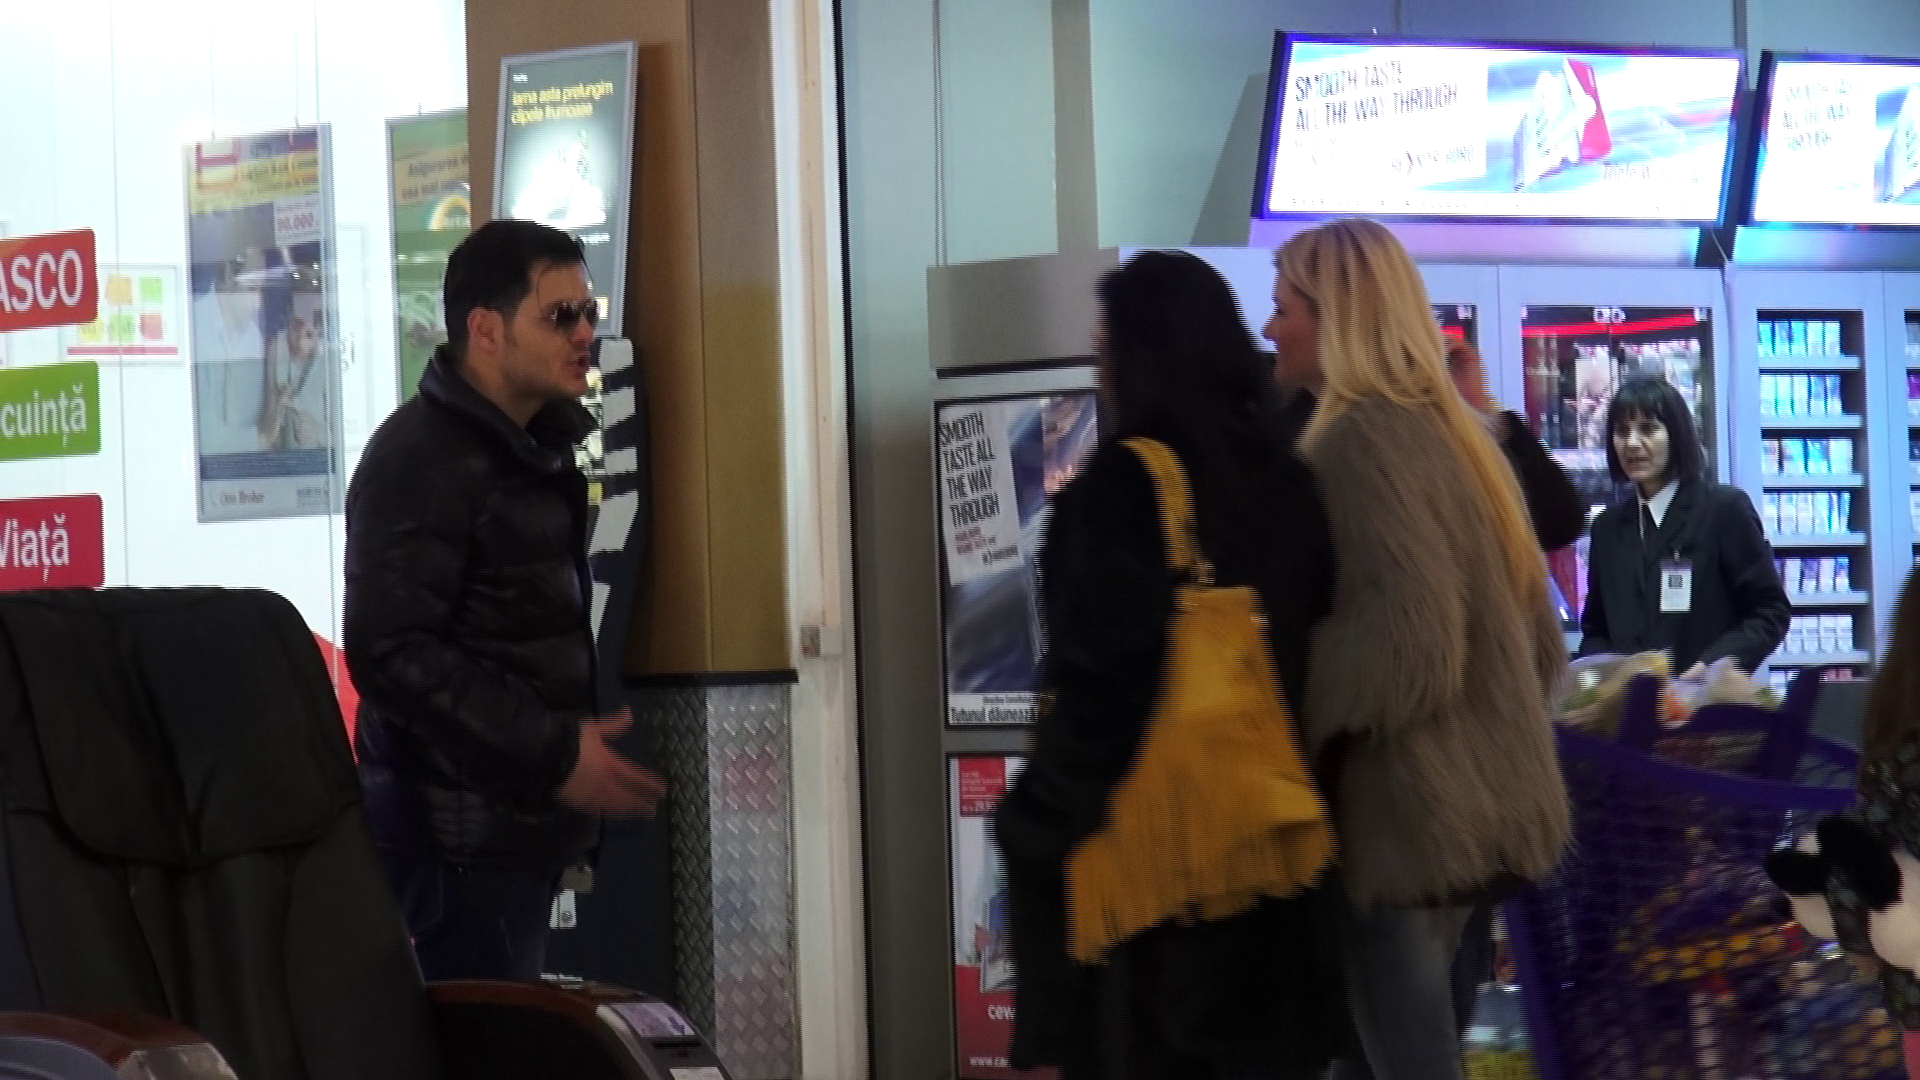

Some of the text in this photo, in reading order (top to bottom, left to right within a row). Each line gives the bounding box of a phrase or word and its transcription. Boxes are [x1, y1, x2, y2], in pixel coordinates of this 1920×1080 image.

[1295, 61, 1403, 102] SMOOTH TASTE
[1325, 101, 1347, 127] THE
[1393, 82, 1458, 115] THROUGH
[939, 411, 986, 448] SMOOTH
[943, 436, 996, 474] TASTE ALL
[946, 465, 993, 502] THE WAY
[950, 492, 1000, 529] THROUGH
[951, 708, 987, 722] Tutunul
